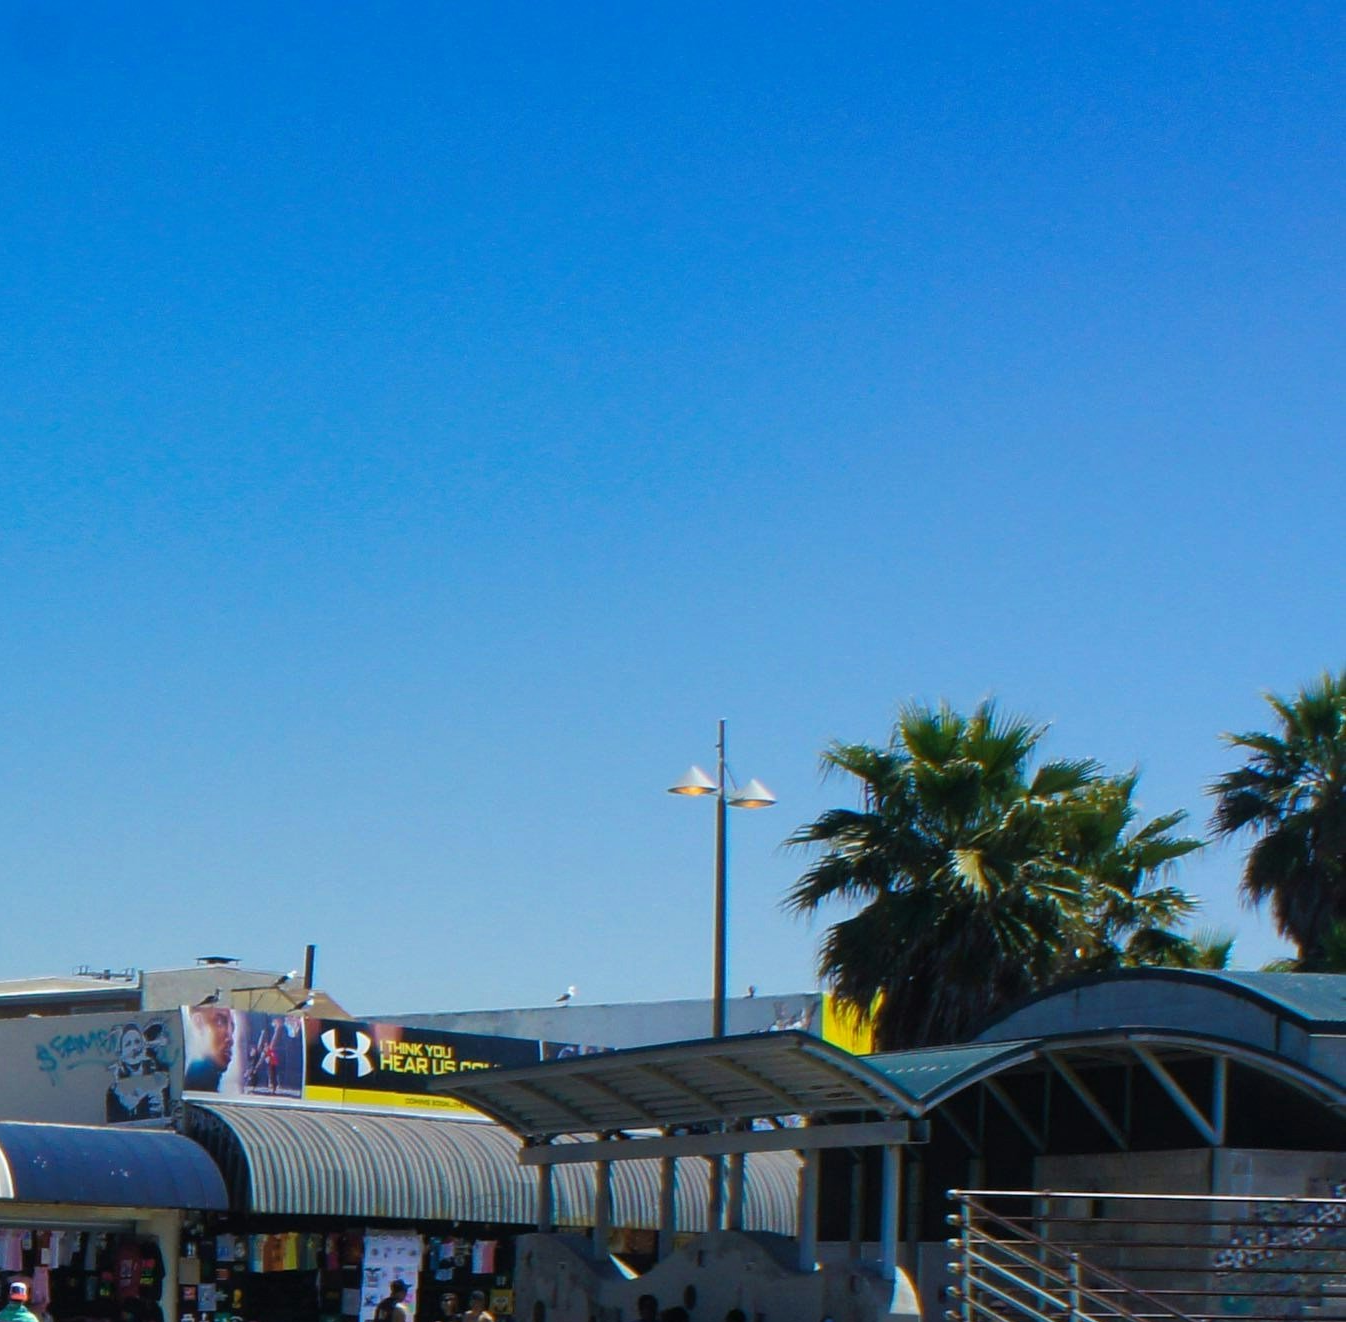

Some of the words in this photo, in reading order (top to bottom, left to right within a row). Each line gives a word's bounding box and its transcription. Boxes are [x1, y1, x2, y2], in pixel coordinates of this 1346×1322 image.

[386, 1041, 423, 1056] THINK
[426, 1044, 452, 1059] YOU
[380, 1055, 429, 1074] HEAR
[432, 1060, 456, 1075] US
